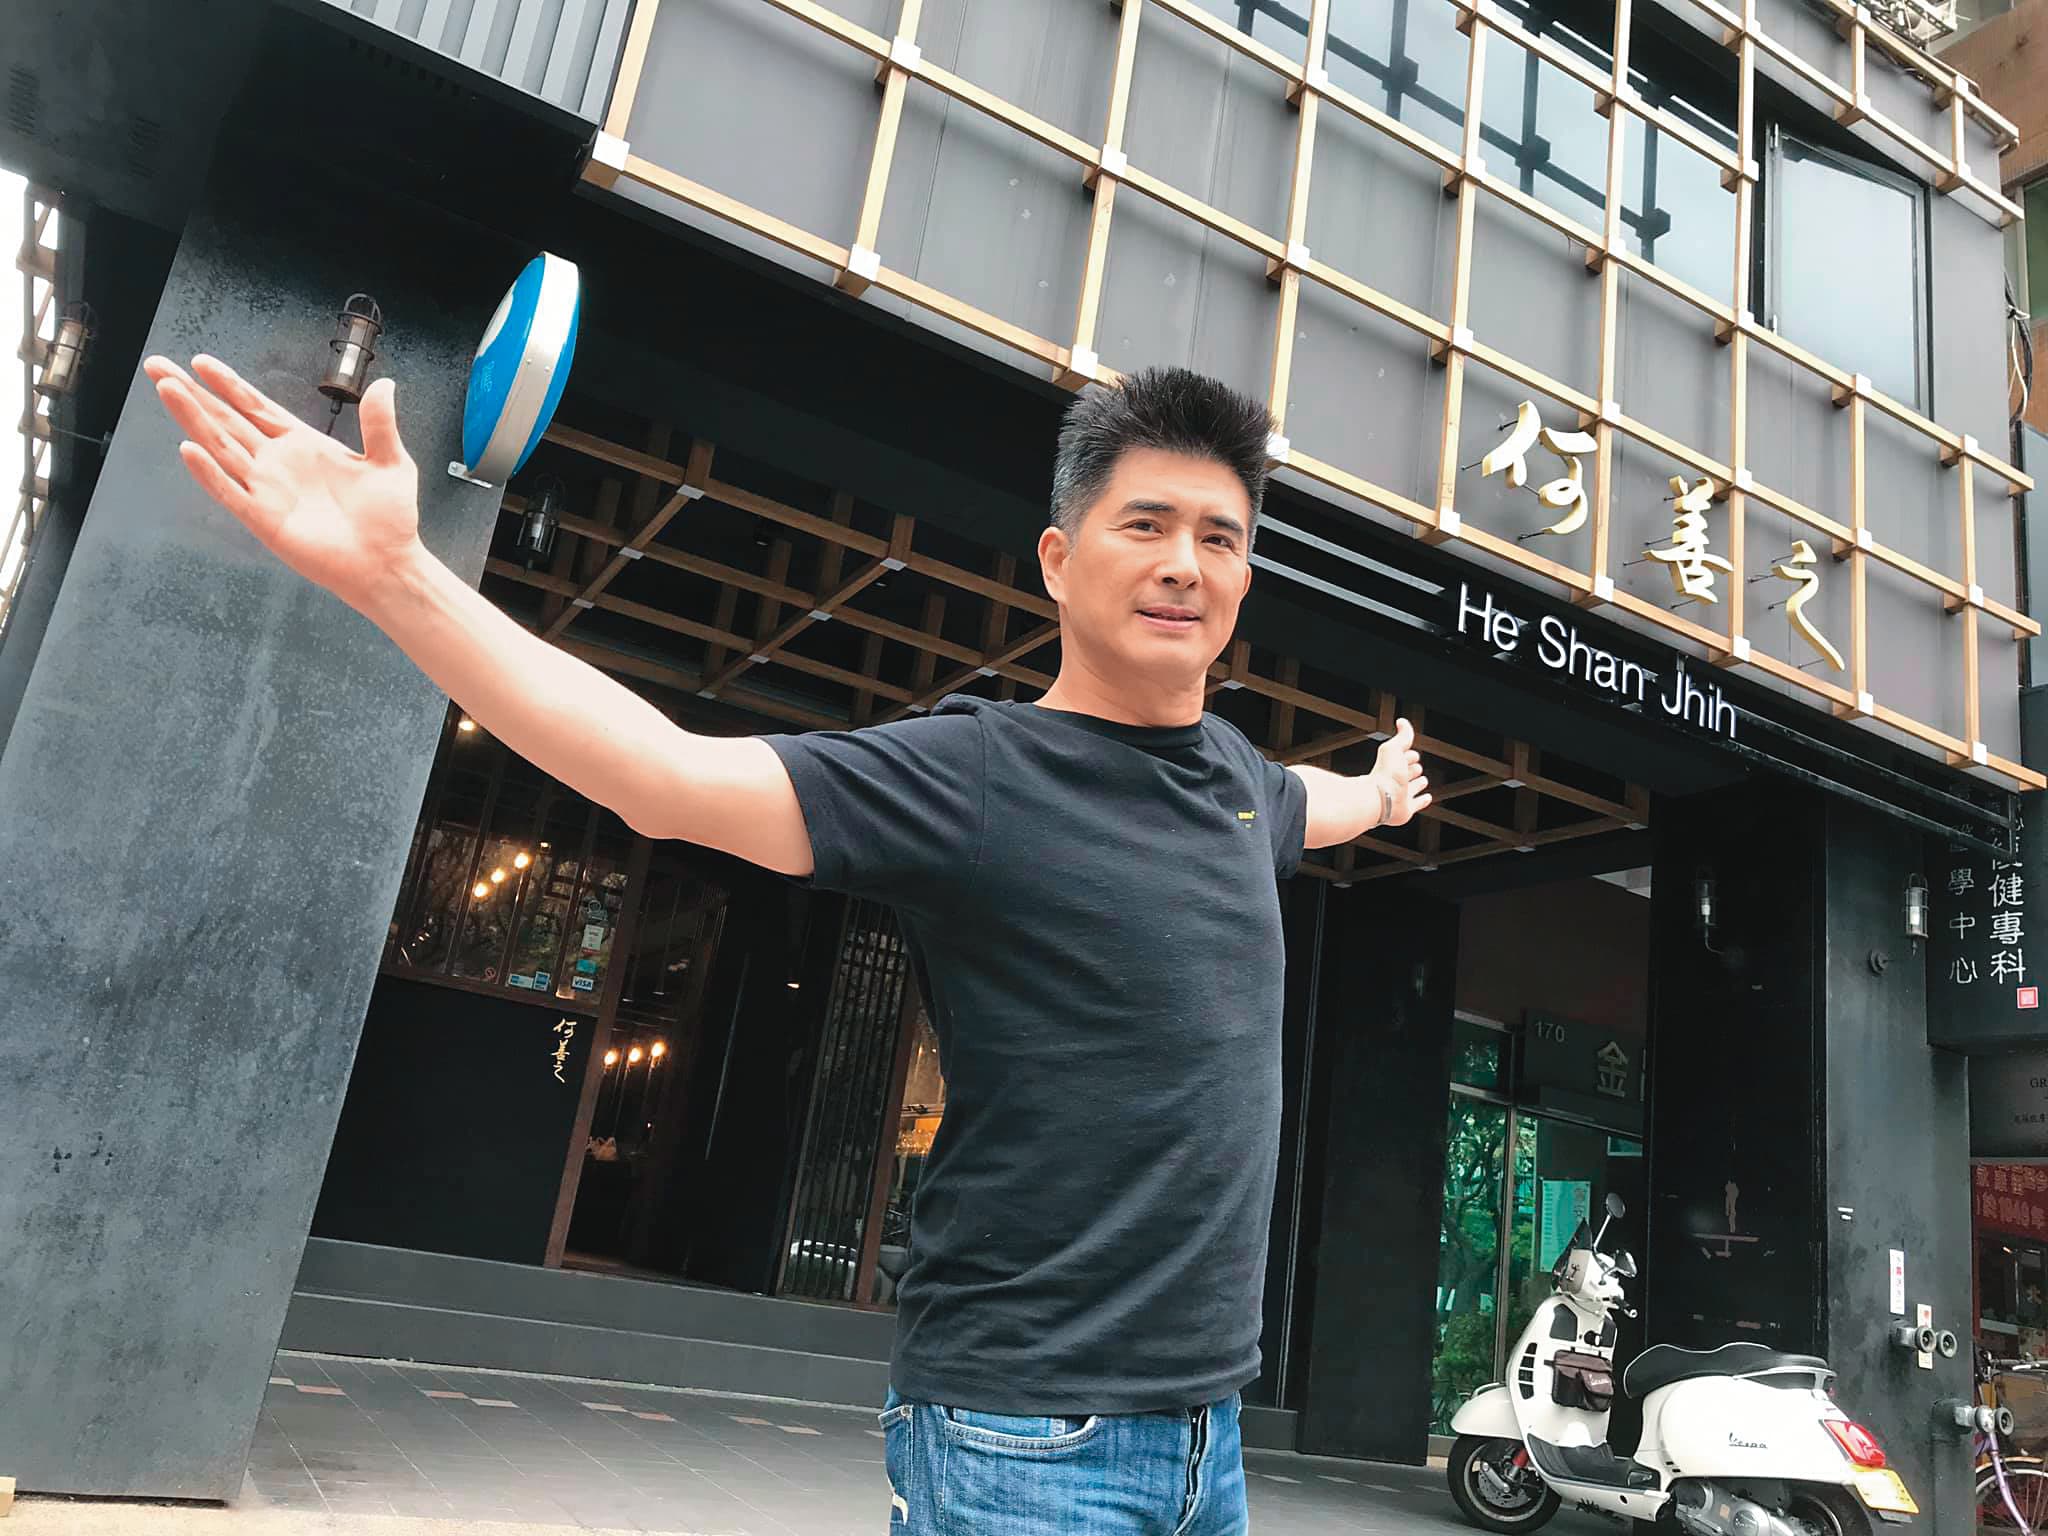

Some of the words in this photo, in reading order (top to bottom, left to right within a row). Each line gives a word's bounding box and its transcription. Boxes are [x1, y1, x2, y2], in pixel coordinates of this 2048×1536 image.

[1480, 400, 1847, 672] 何善之
[1458, 581, 1520, 651] He
[1537, 614, 1644, 701] Shan
[1661, 668, 1737, 738] Jhih
[551, 1018, 577, 1083] 何善之
[1536, 1020, 1565, 1043] 170
